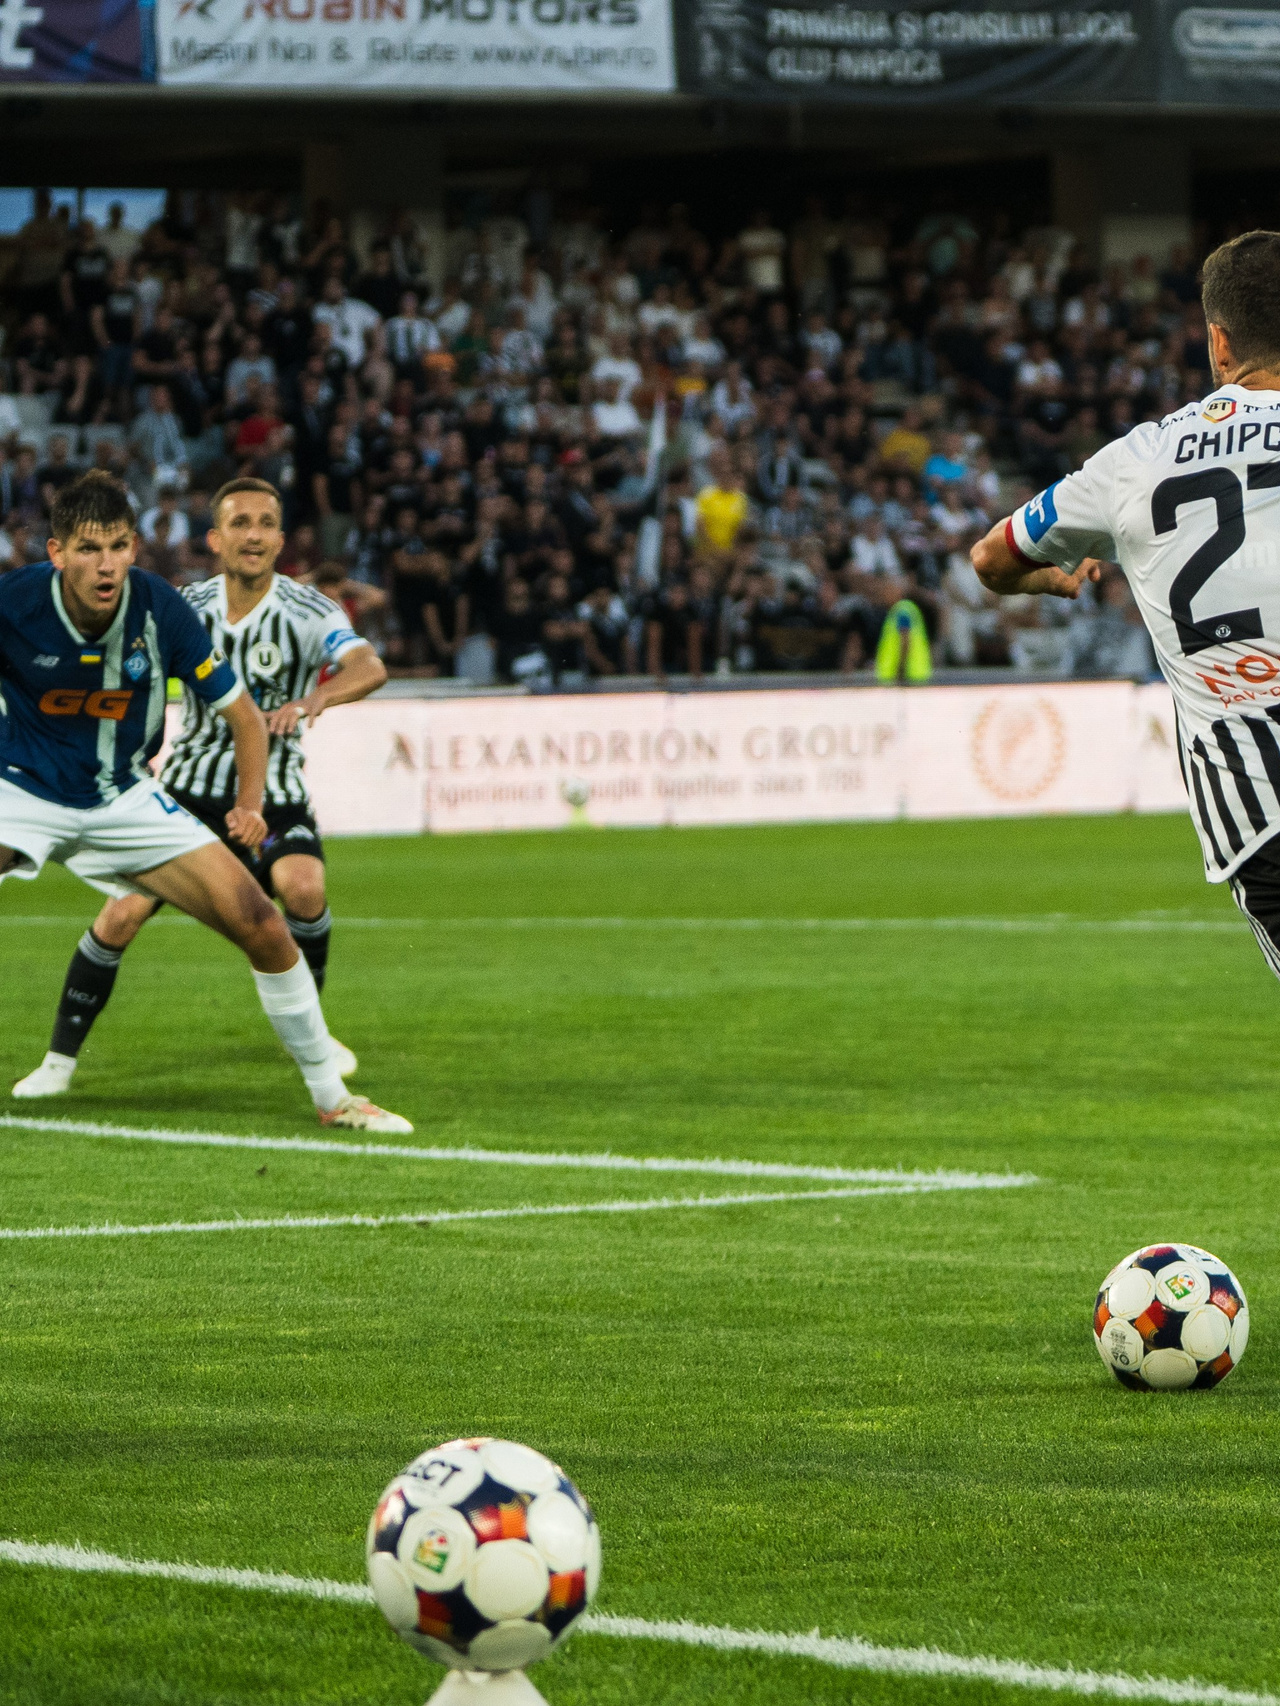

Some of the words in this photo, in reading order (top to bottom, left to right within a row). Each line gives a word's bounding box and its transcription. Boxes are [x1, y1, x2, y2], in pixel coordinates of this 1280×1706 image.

[39, 688, 134, 721] GG
[385, 726, 721, 772] ALEXANDRION
[741, 720, 897, 763] GROUP
